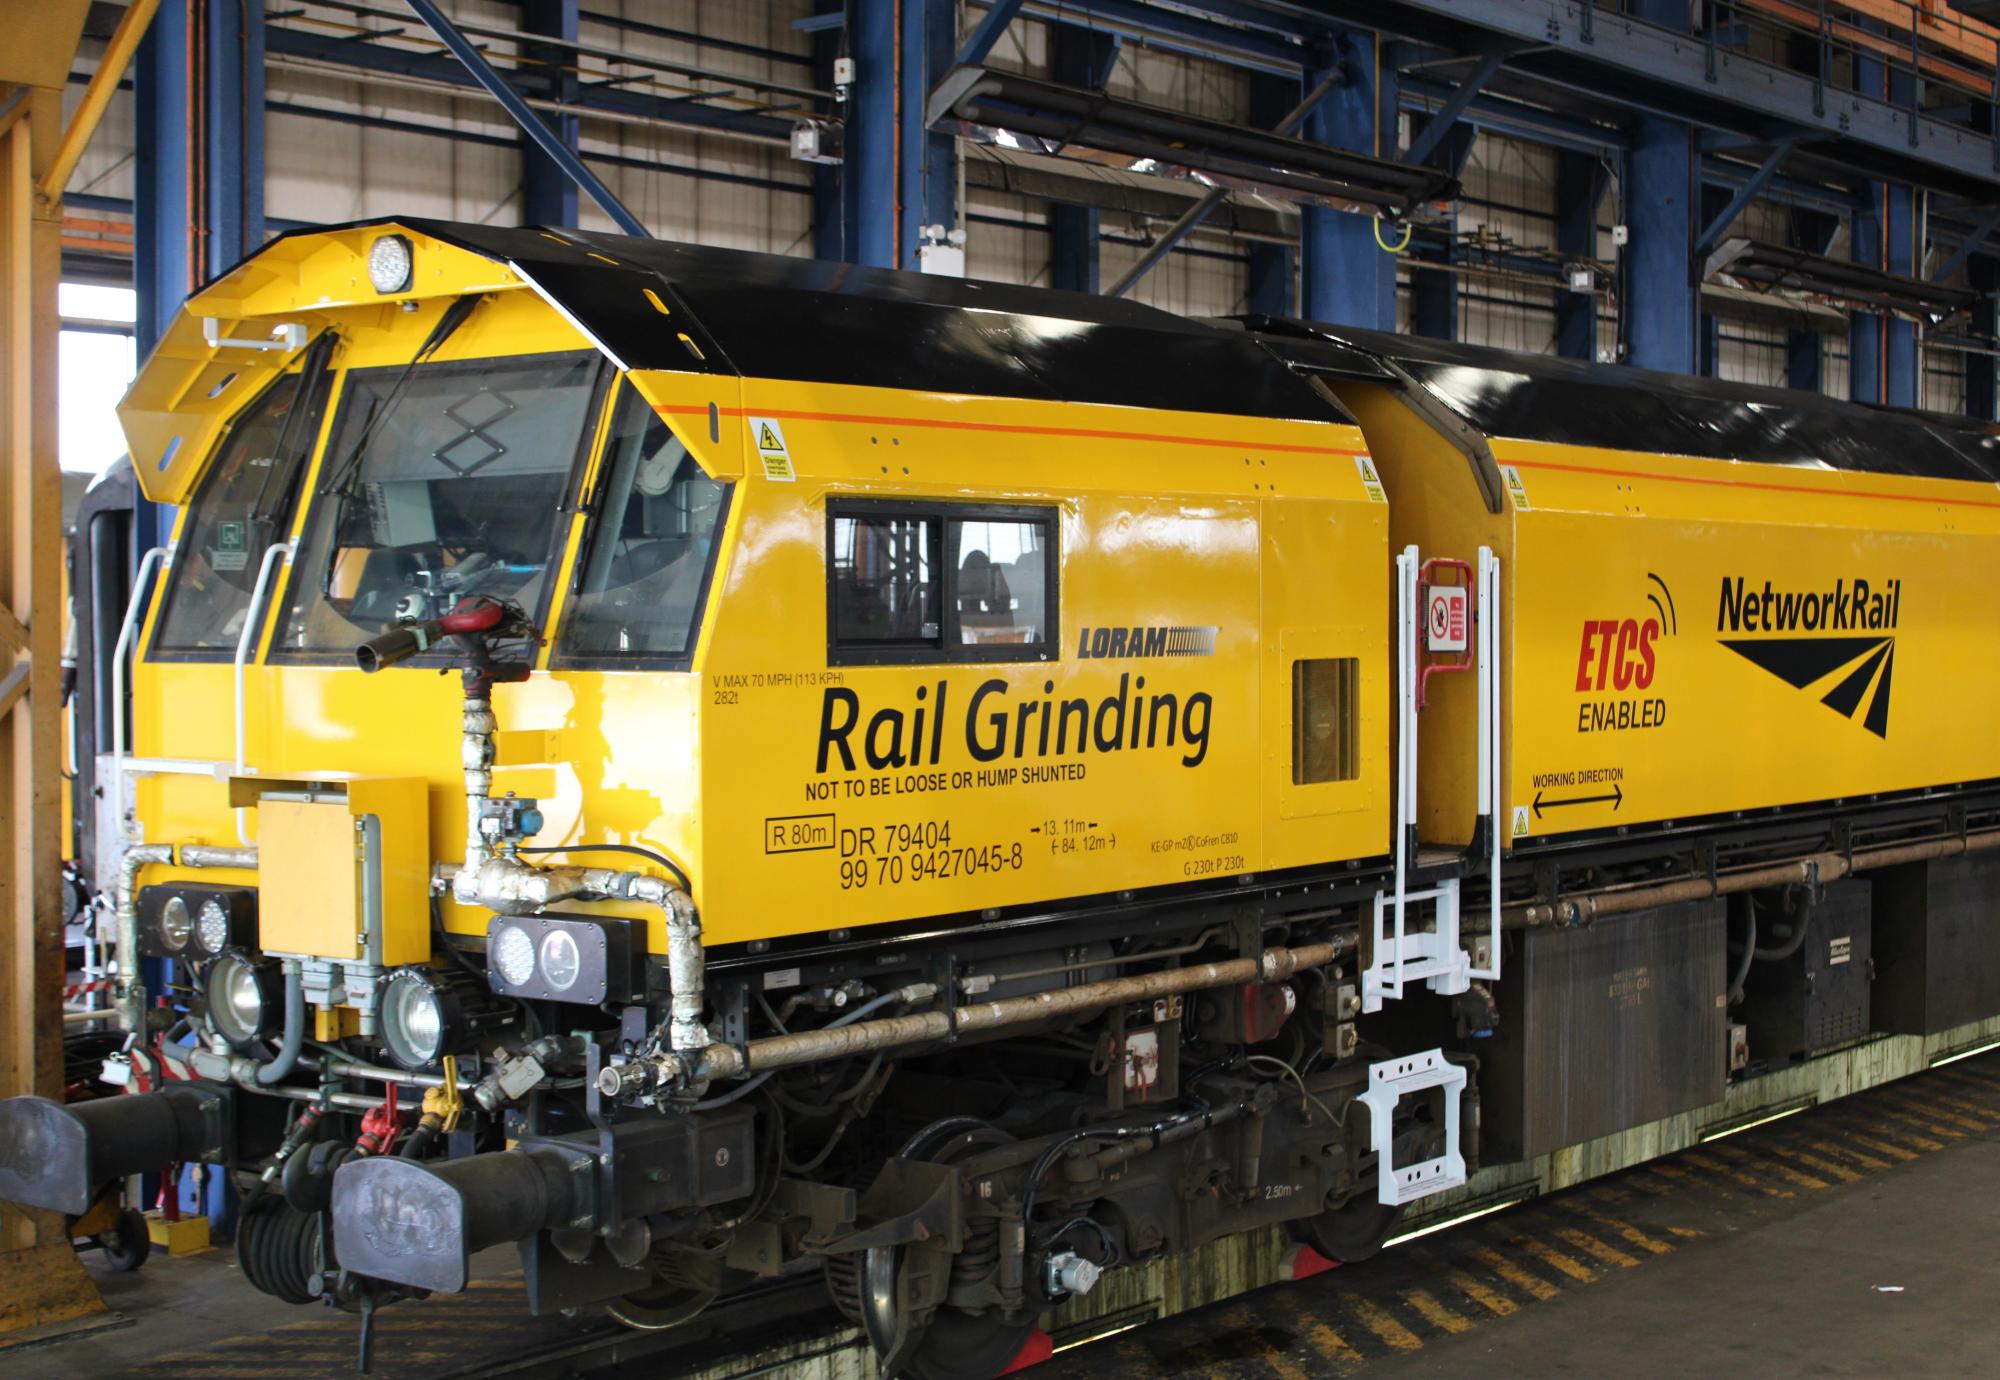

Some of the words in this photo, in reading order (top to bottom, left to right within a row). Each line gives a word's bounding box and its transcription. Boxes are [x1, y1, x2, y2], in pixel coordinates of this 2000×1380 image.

[1717, 576, 1901, 632] NetworkRail
[1077, 626, 1168, 659] LORAM
[1575, 618, 1660, 692] ETCS
[713, 675, 721, 688] V
[723, 675, 749, 688] MAX
[752, 674, 764, 687] 70
[767, 673, 792, 686] MPH
[795, 672, 816, 687] (113
[819, 672, 845, 685] KPH)
[714, 690, 739, 705] 282t
[815, 679, 948, 774] Rail
[965, 672, 1213, 769] Grinding
[1577, 699, 1666, 733] ENABLED
[805, 781, 840, 801] NOT
[844, 779, 865, 798] TO
[870, 777, 890, 796] BE
[895, 773, 947, 794] LOOSE
[951, 771, 973, 789] OR
[977, 768, 1017, 787] HUMP
[1021, 763, 1086, 784] SHUNTED
[1532, 771, 1575, 788] WORKING
[1578, 768, 1623, 785] DIRECTION
[773, 825, 786, 847] R
[791, 823, 827, 845] 80m
[841, 827, 876, 858] DR
[884, 820, 951, 854] 79404
[1151, 839, 1173, 853] KE-GP
[840, 859, 868, 890] 99
[876, 855, 903, 886] 70
[910, 842, 1023, 882] 9427045-8
[1183, 861, 1191, 876] G
[1193, 859, 1214, 875] 230t
[1216, 858, 1223, 872] P
[1224, 855, 1245, 871] 230t
[979, 1180, 993, 1200] 16
[1265, 1184, 1293, 1201] 2.50m
